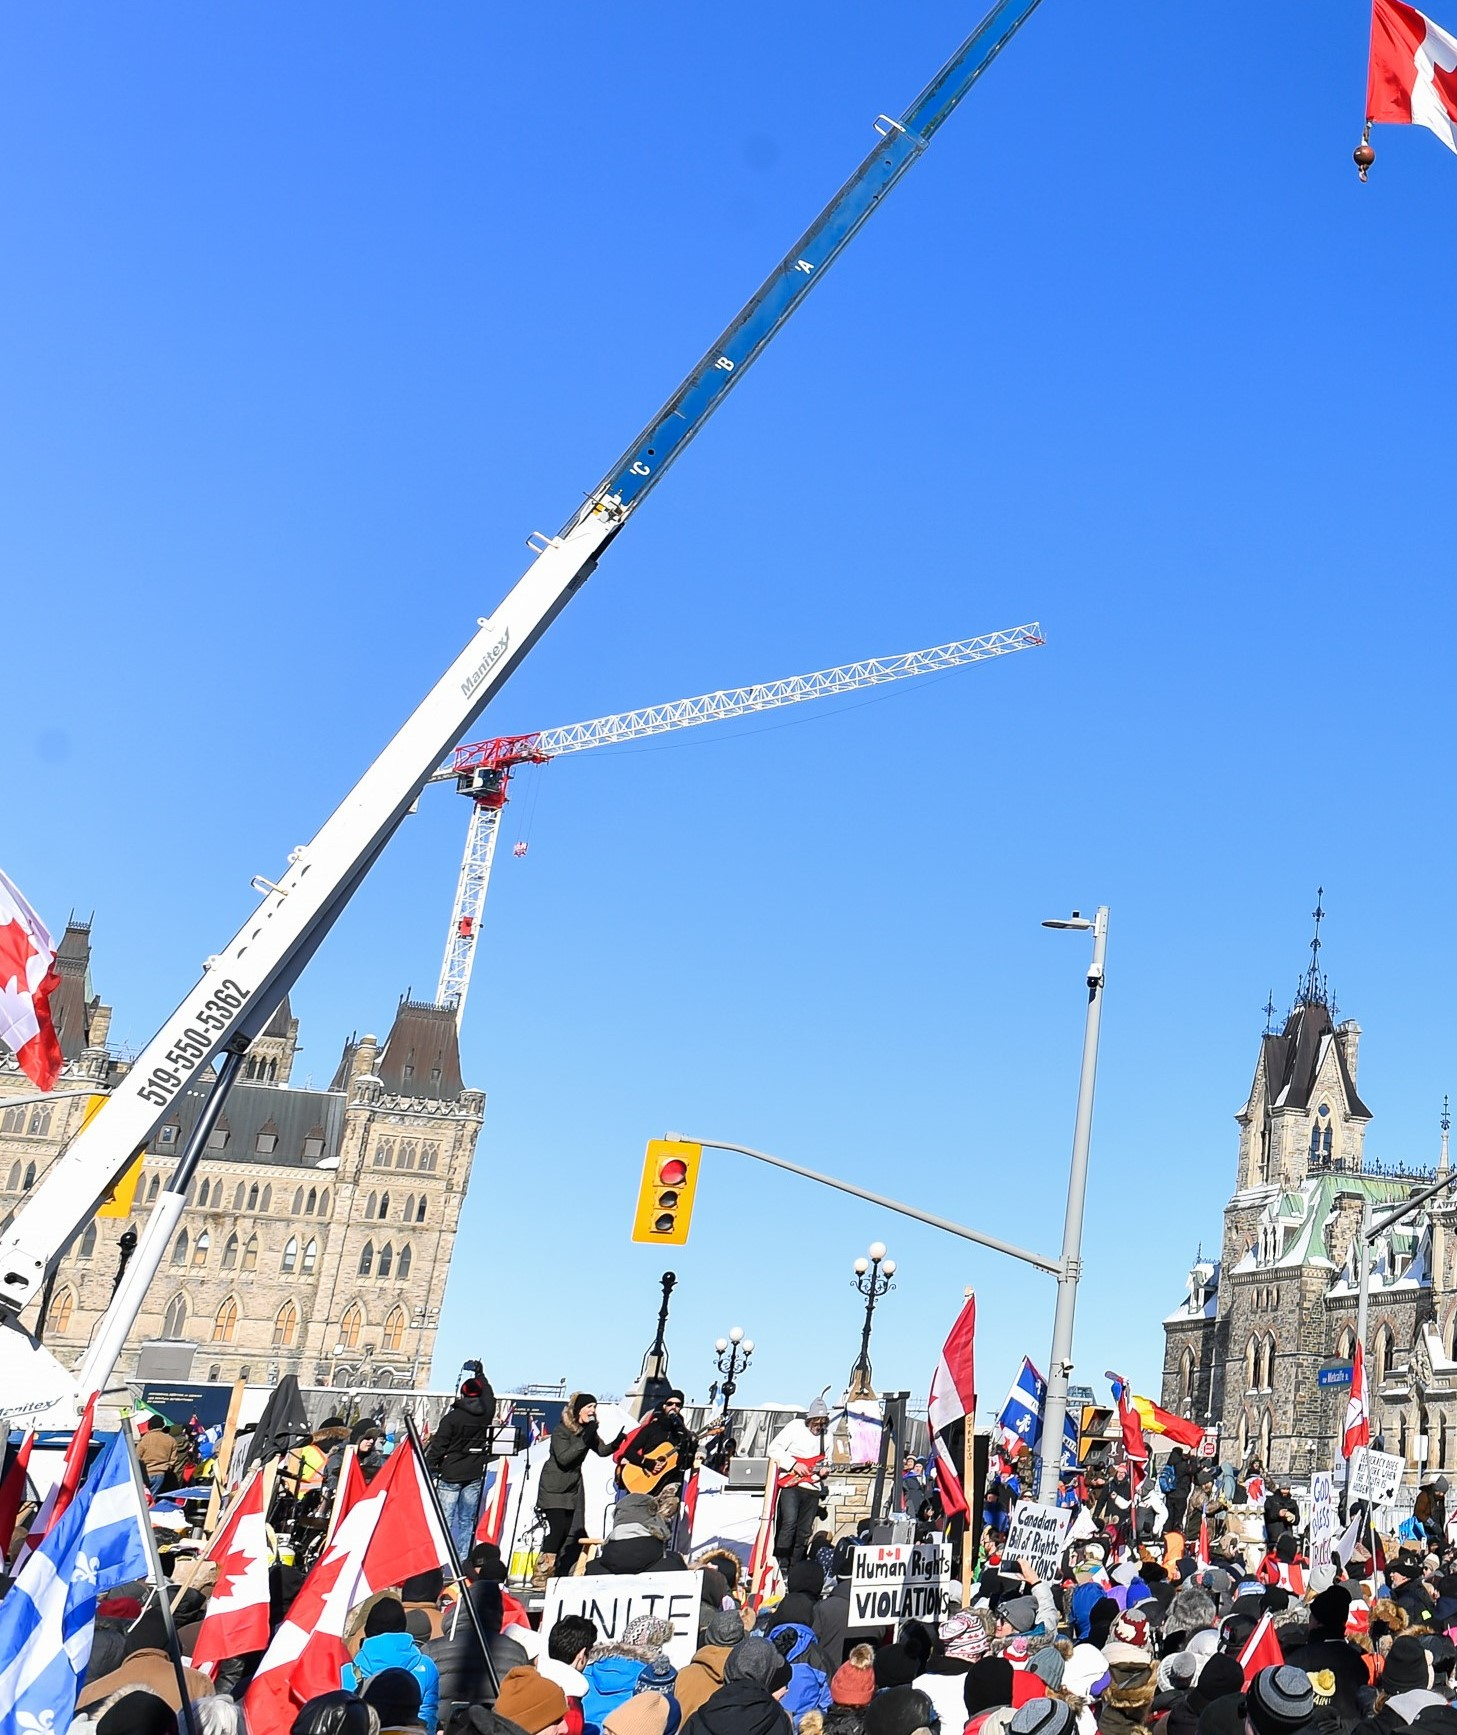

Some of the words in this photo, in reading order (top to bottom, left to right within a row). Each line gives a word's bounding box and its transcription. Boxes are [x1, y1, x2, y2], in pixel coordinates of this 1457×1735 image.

[460, 636, 508, 697] Manitex
[137, 979, 251, 1107] 519-550-5362
[0, 1400, 54, 1416] anitex
[1314, 1476, 1330, 1503] GOD
[1017, 1506, 1058, 1533] Canadian
[1312, 1506, 1330, 1537] BLESS
[1008, 1526, 1023, 1550] Bill
[1021, 1530, 1033, 1551] of
[1031, 1532, 1060, 1558] Rights
[856, 1553, 906, 1579] Human
[912, 1548, 950, 1580] Rights
[1006, 1552, 1057, 1582] TIONS
[557, 1594, 694, 1639] UNITE
[855, 1587, 950, 1619] VIOLATIONS
